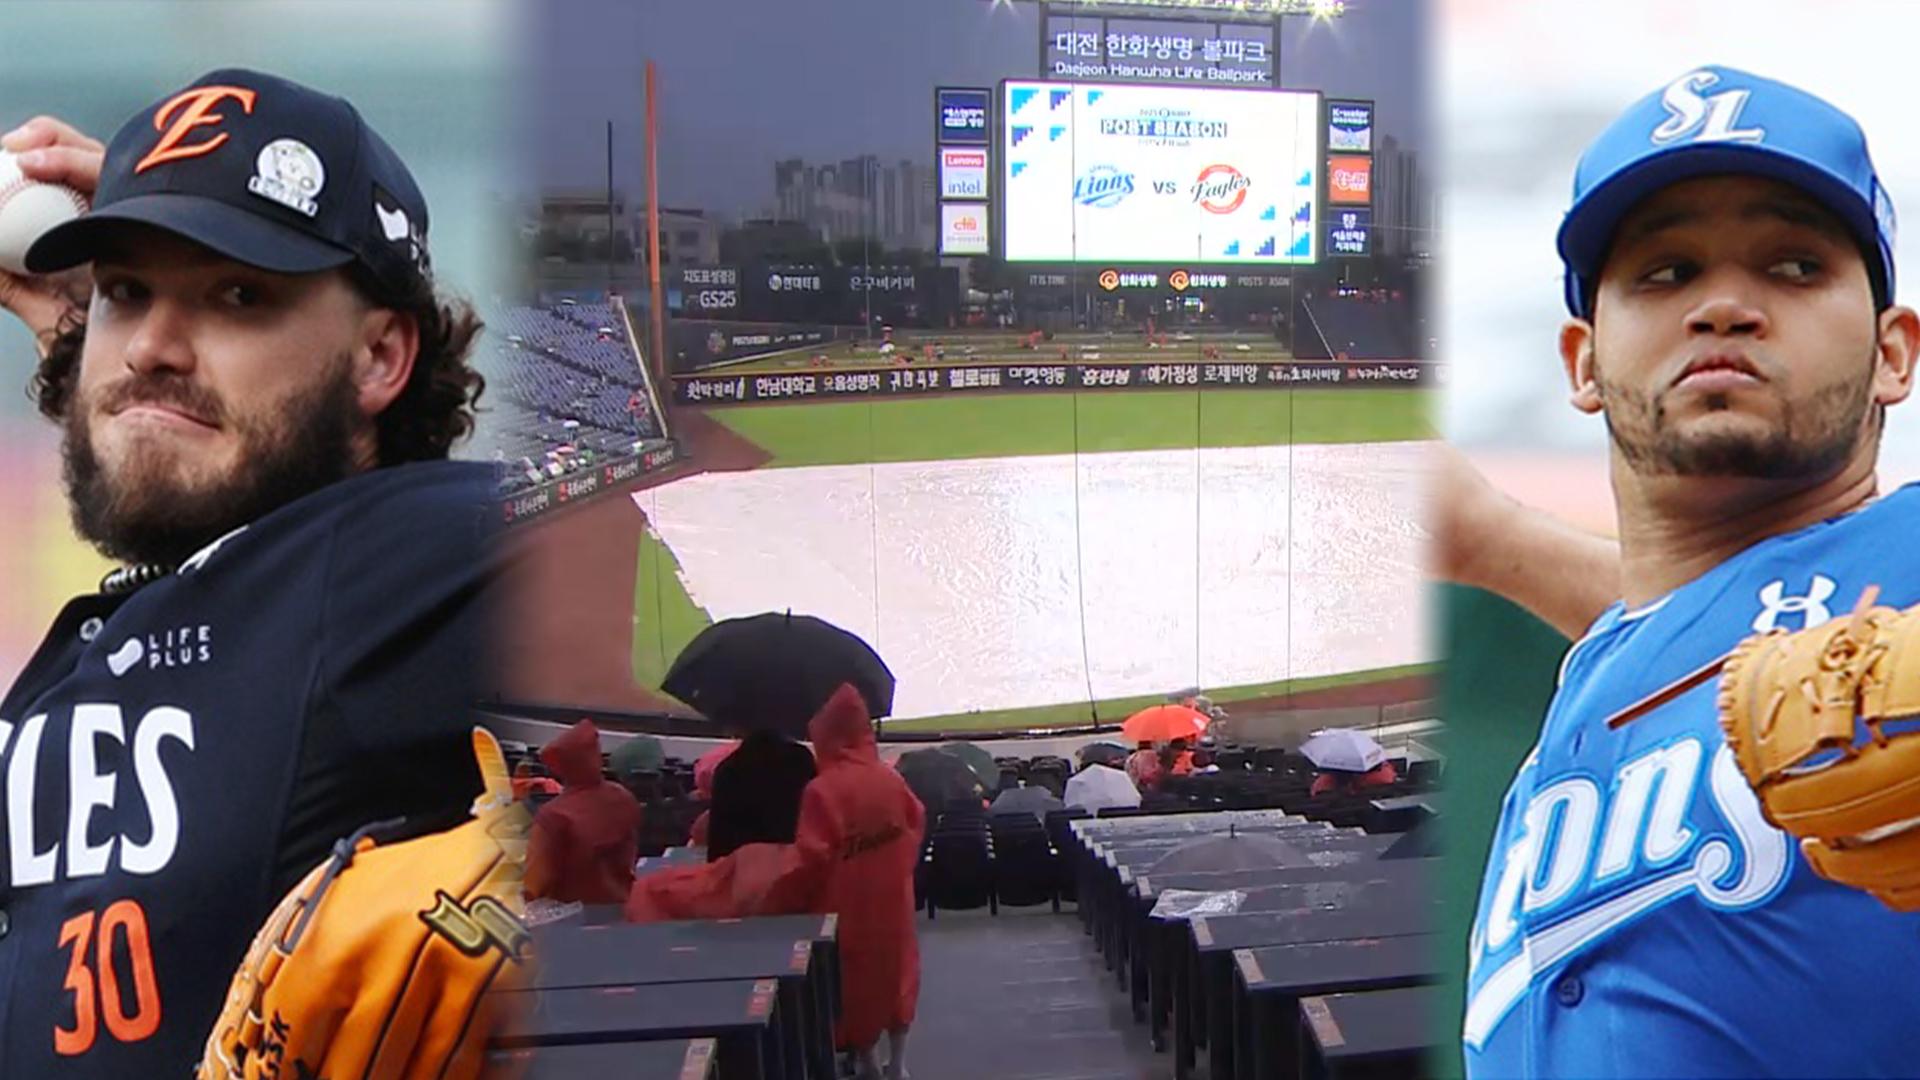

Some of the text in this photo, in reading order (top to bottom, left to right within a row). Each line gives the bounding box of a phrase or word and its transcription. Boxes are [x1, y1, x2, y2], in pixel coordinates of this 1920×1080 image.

[1056, 32, 1266, 63] 대전 한화생명 볼파크
[1055, 61, 1266, 83] Daejeon Hanwha Life Ballpark
[134, 85, 258, 174] E
[1102, 119, 1227, 138] POST SEASON
[947, 155, 983, 165] Lenovo
[948, 179, 981, 194] intel
[1074, 174, 1135, 202] Lions
[1190, 175, 1251, 203] Eagles
[699, 290, 737, 308] GS25
[834, 373, 881, 392] 음성명작
[1203, 364, 1258, 384] 로제비앙
[755, 375, 817, 397] 한남대학교
[149, 625, 211, 649] LIFE
[149, 646, 211, 669] PLUS
[0, 703, 195, 887] LES
[1484, 737, 1793, 950] ions
[54, 899, 162, 1056] 30
